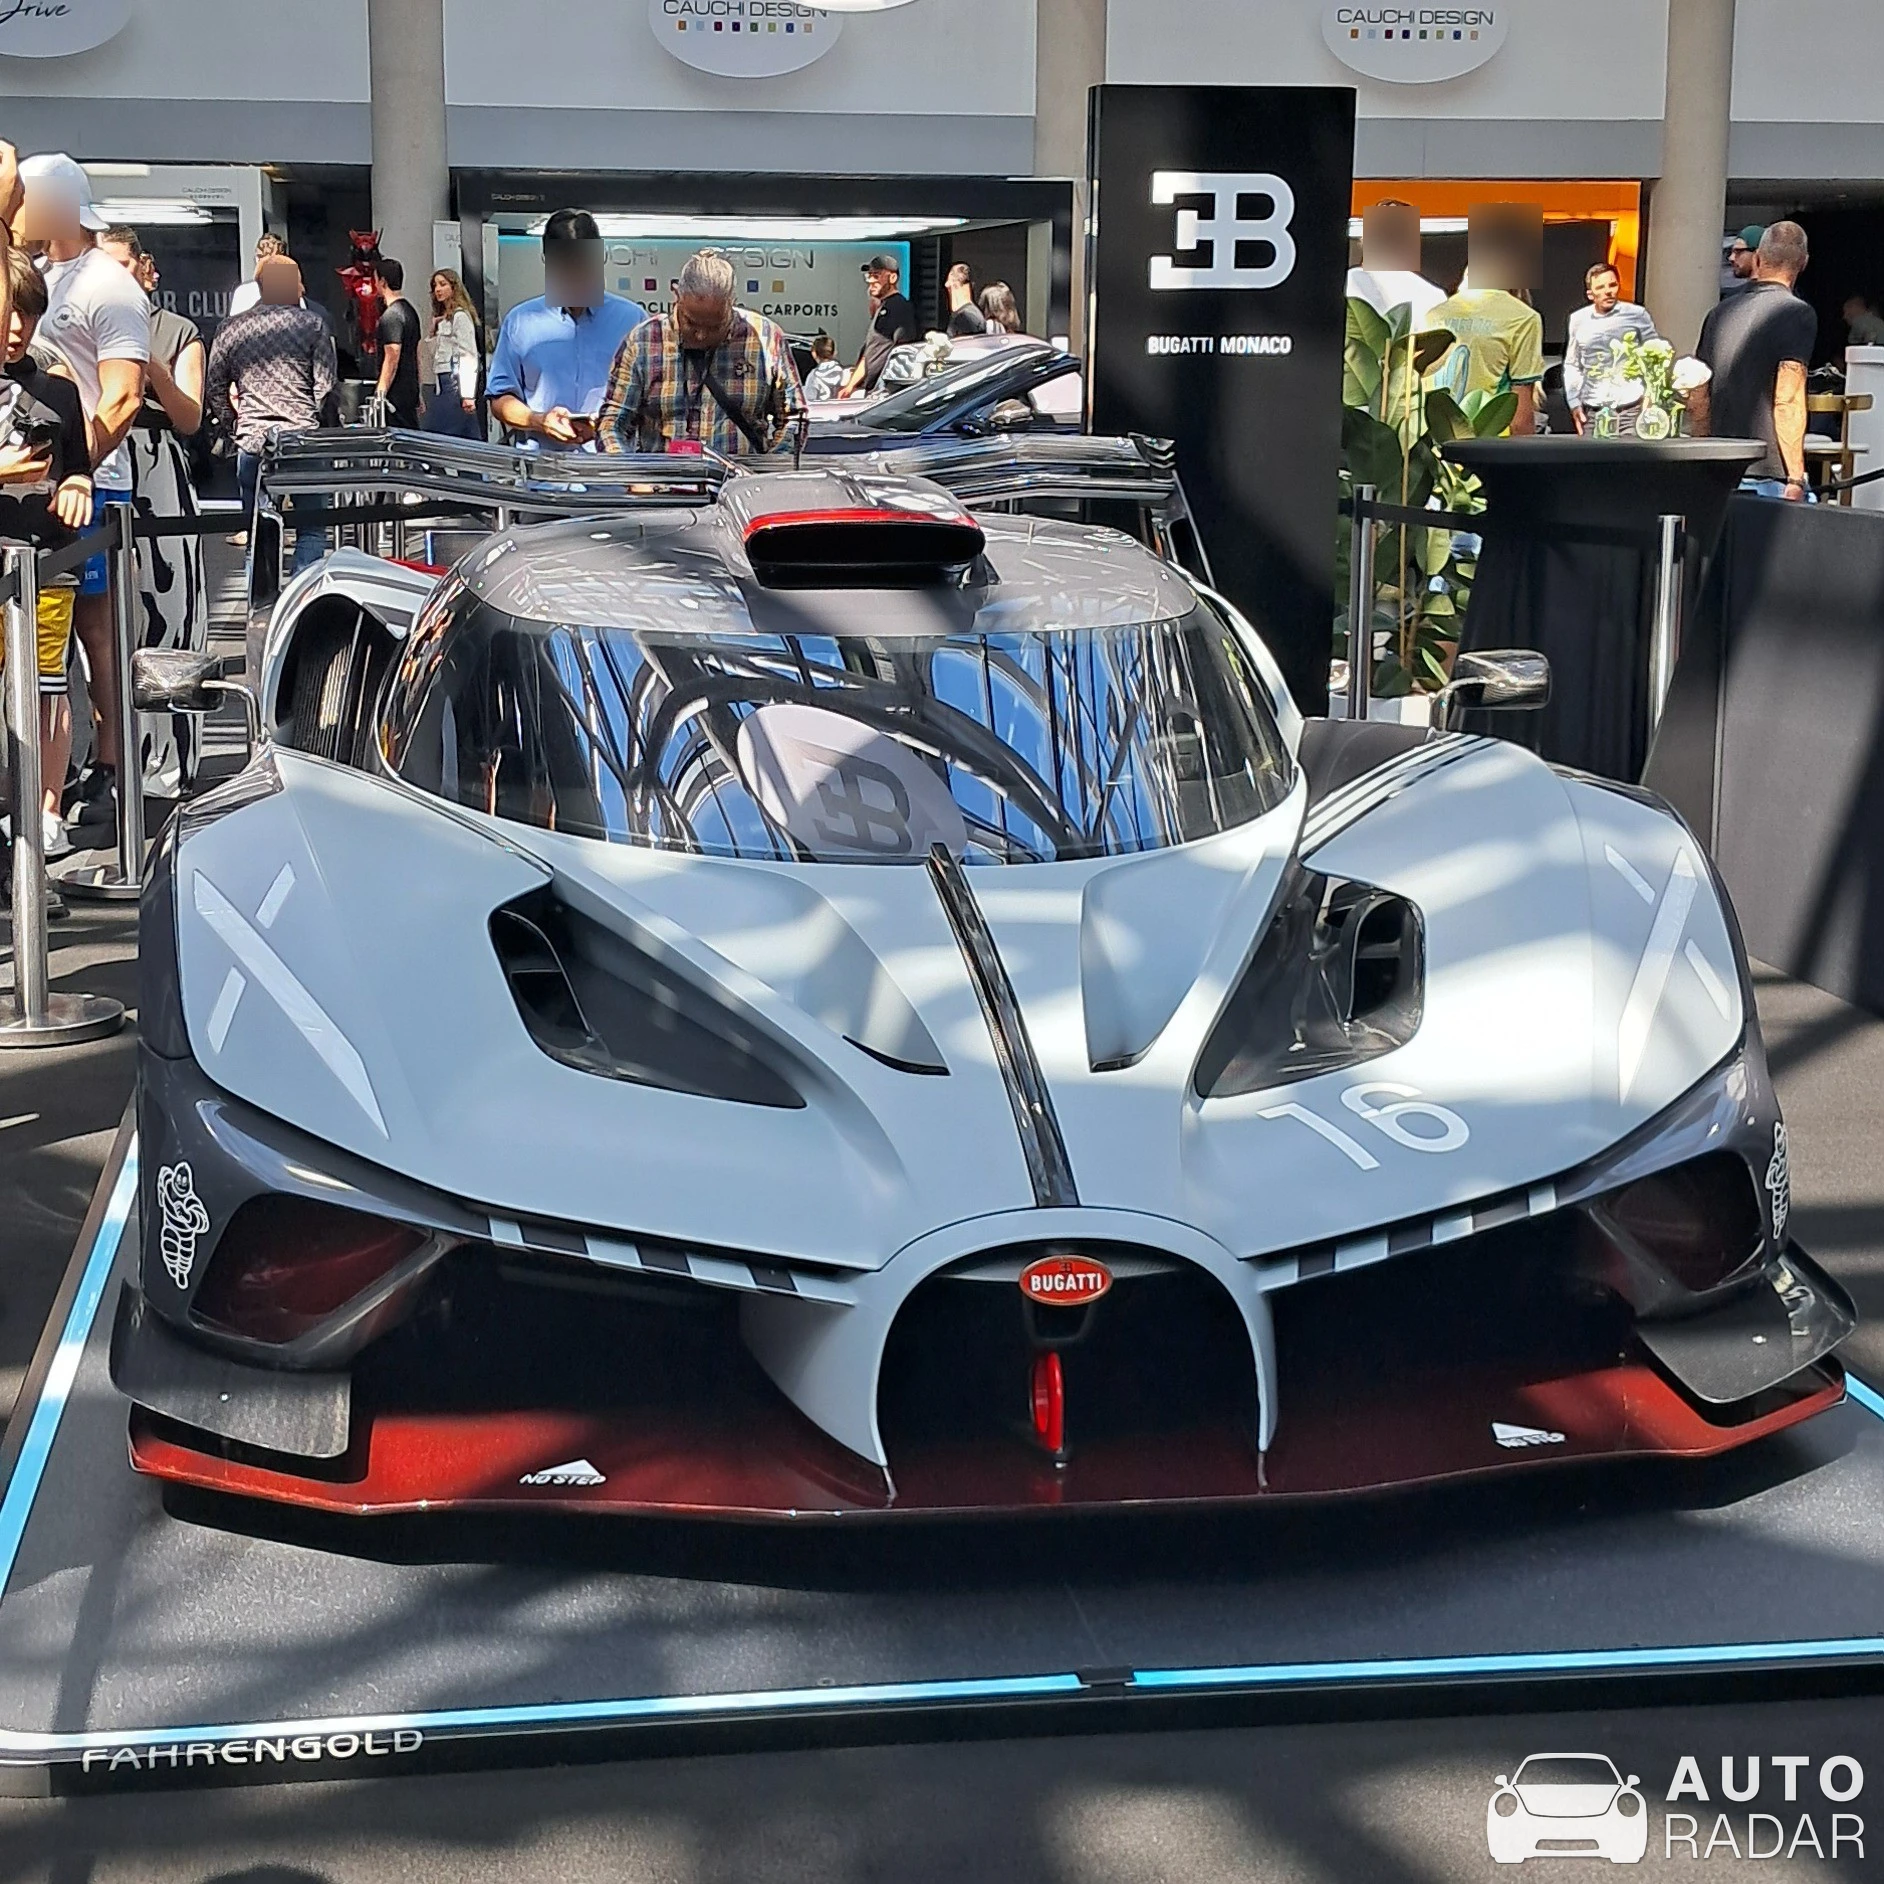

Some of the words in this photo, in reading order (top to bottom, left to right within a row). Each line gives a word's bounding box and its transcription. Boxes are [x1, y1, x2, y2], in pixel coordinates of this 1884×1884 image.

[663, 0, 745, 16] CAUCHI
[1337, 9, 1415, 24] CAUCHI
[1419, 10, 1494, 26] DESIGN
[188, 291, 232, 318] CLU
[762, 304, 839, 317] CARPORTS
[1149, 336, 1213, 354] BUGATTI
[1220, 336, 1293, 354] MONACO
[1256, 1082, 1469, 1170] 16
[1030, 1273, 1102, 1293] BUGATTI
[519, 1474, 551, 1485] NO
[553, 1475, 607, 1486] STEP
[82, 1730, 424, 1773] FAHRENGOLD
